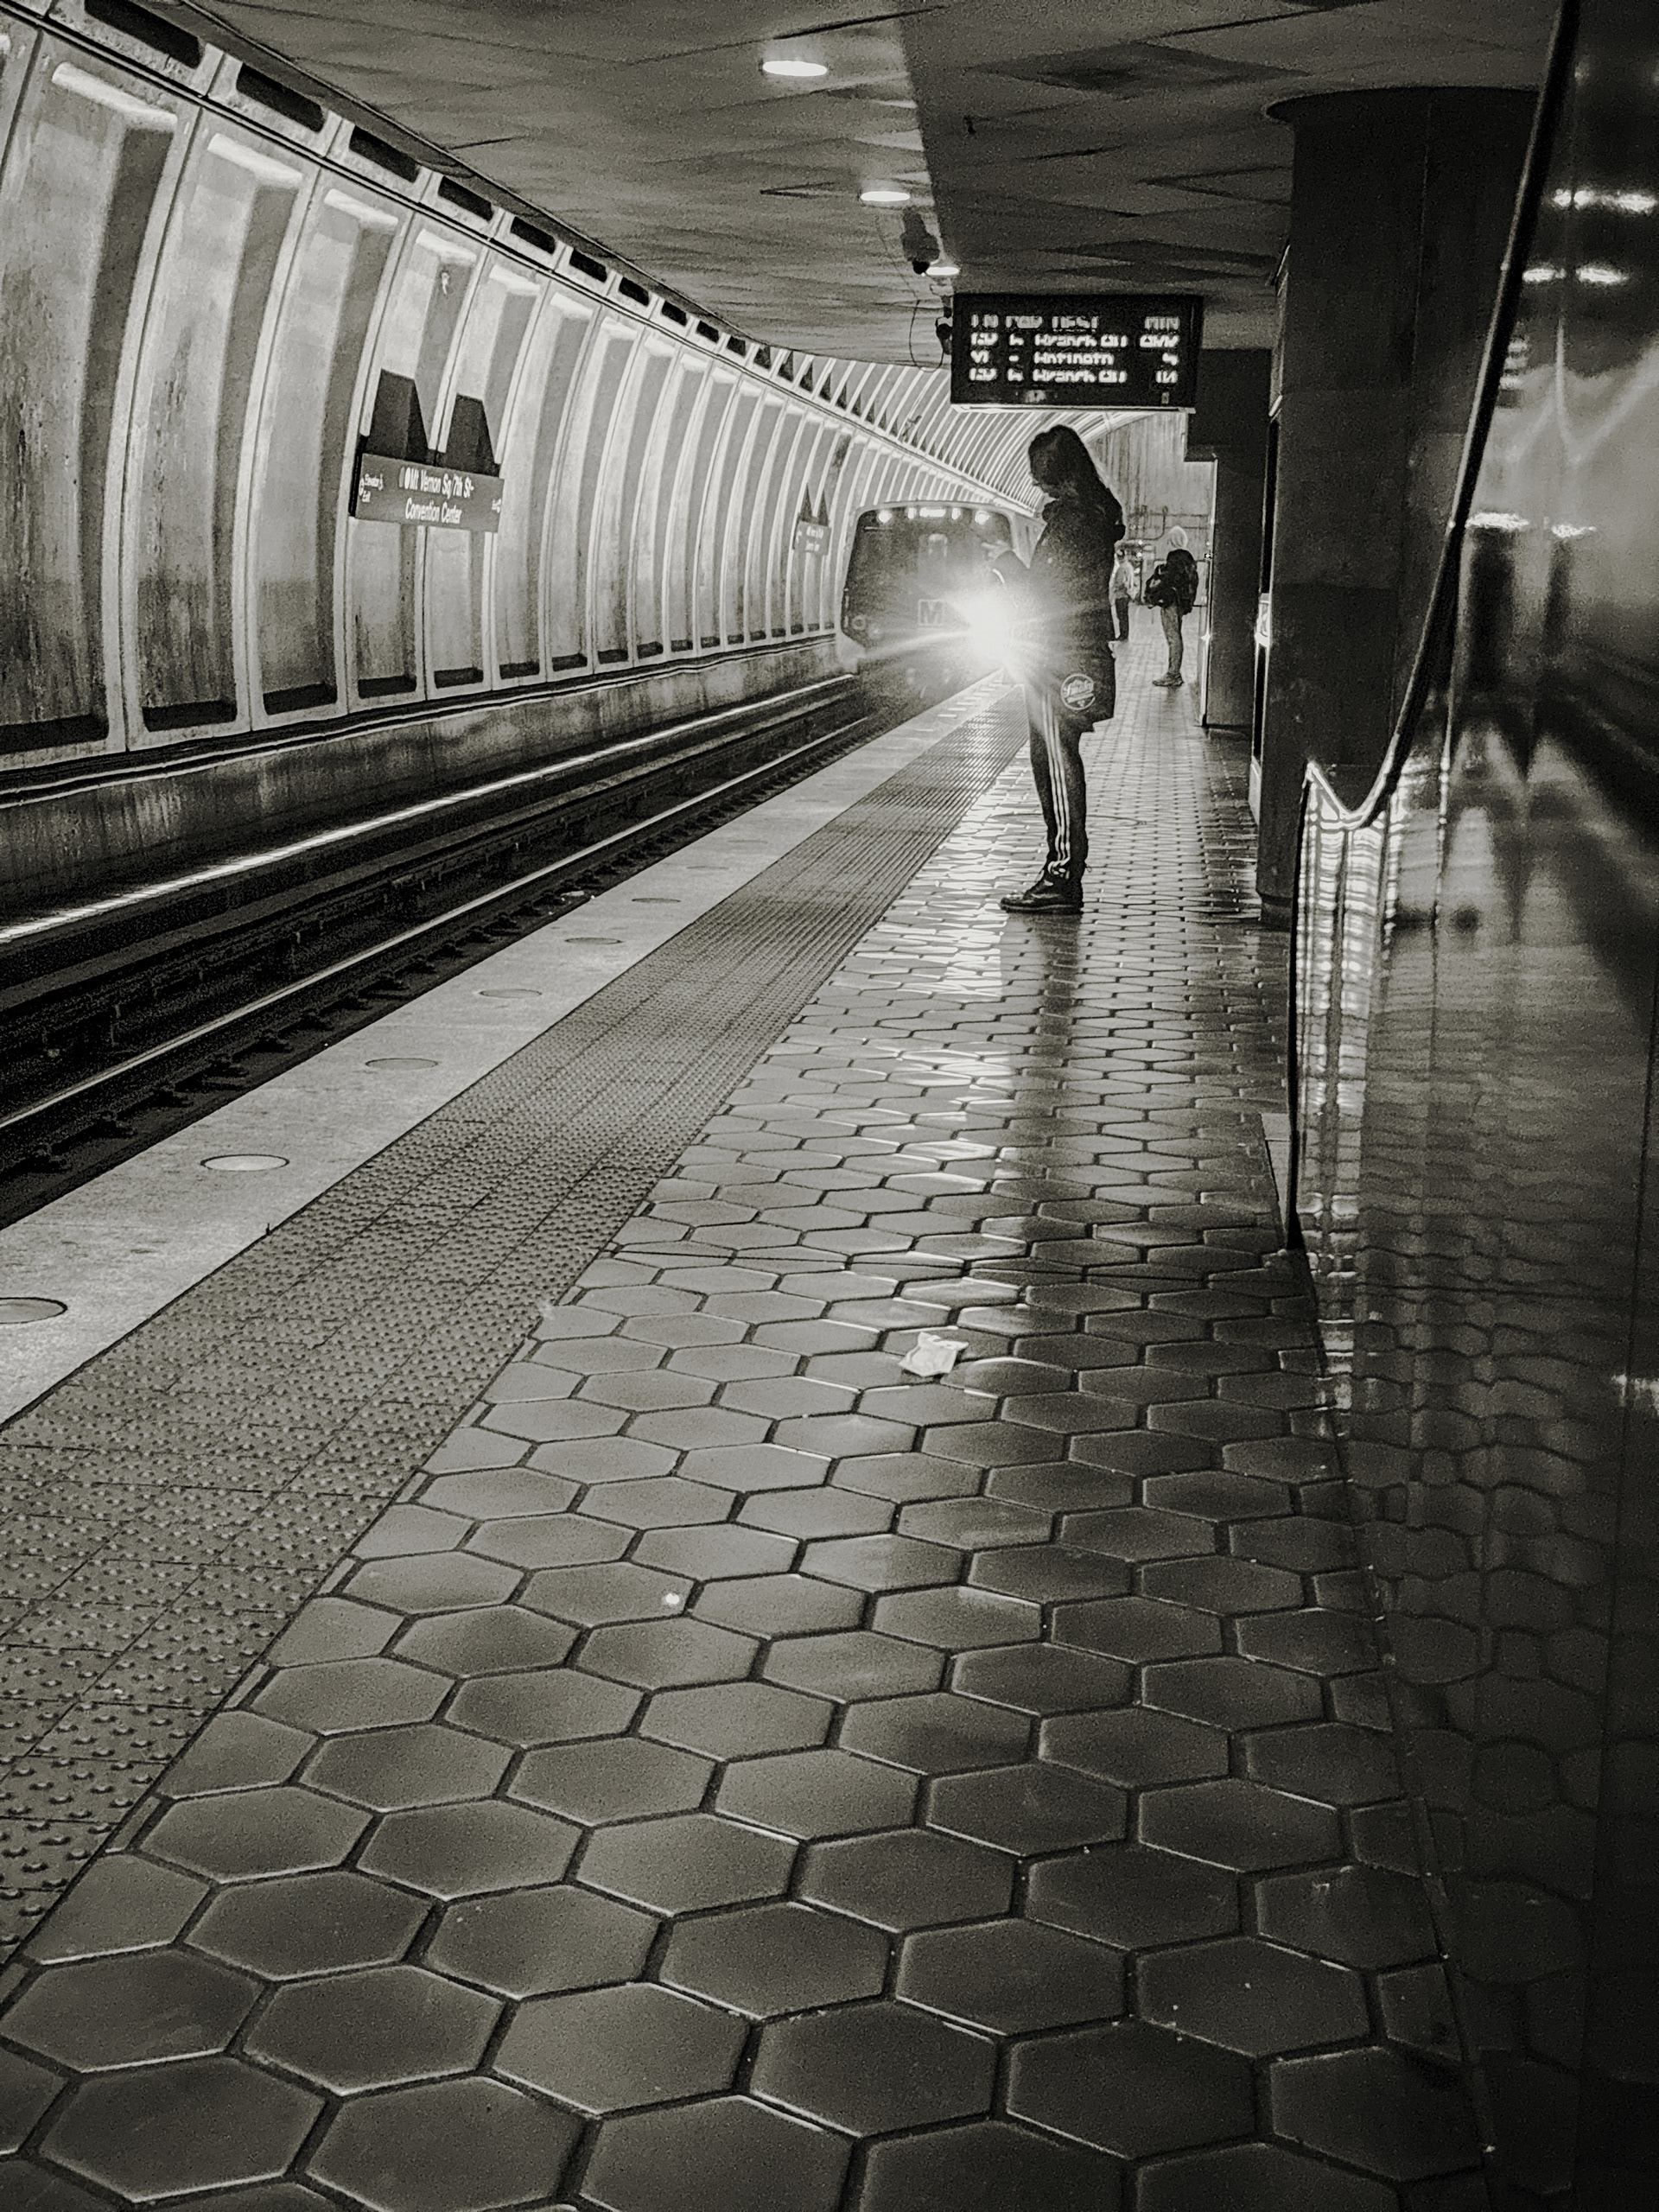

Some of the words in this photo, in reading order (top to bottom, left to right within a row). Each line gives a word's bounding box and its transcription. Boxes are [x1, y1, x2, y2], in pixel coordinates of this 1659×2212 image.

[420, 469, 442, 493] Vernon
[405, 497, 441, 522] Convention
[441, 501, 463, 525] Center
[920, 601, 943, 625] M
